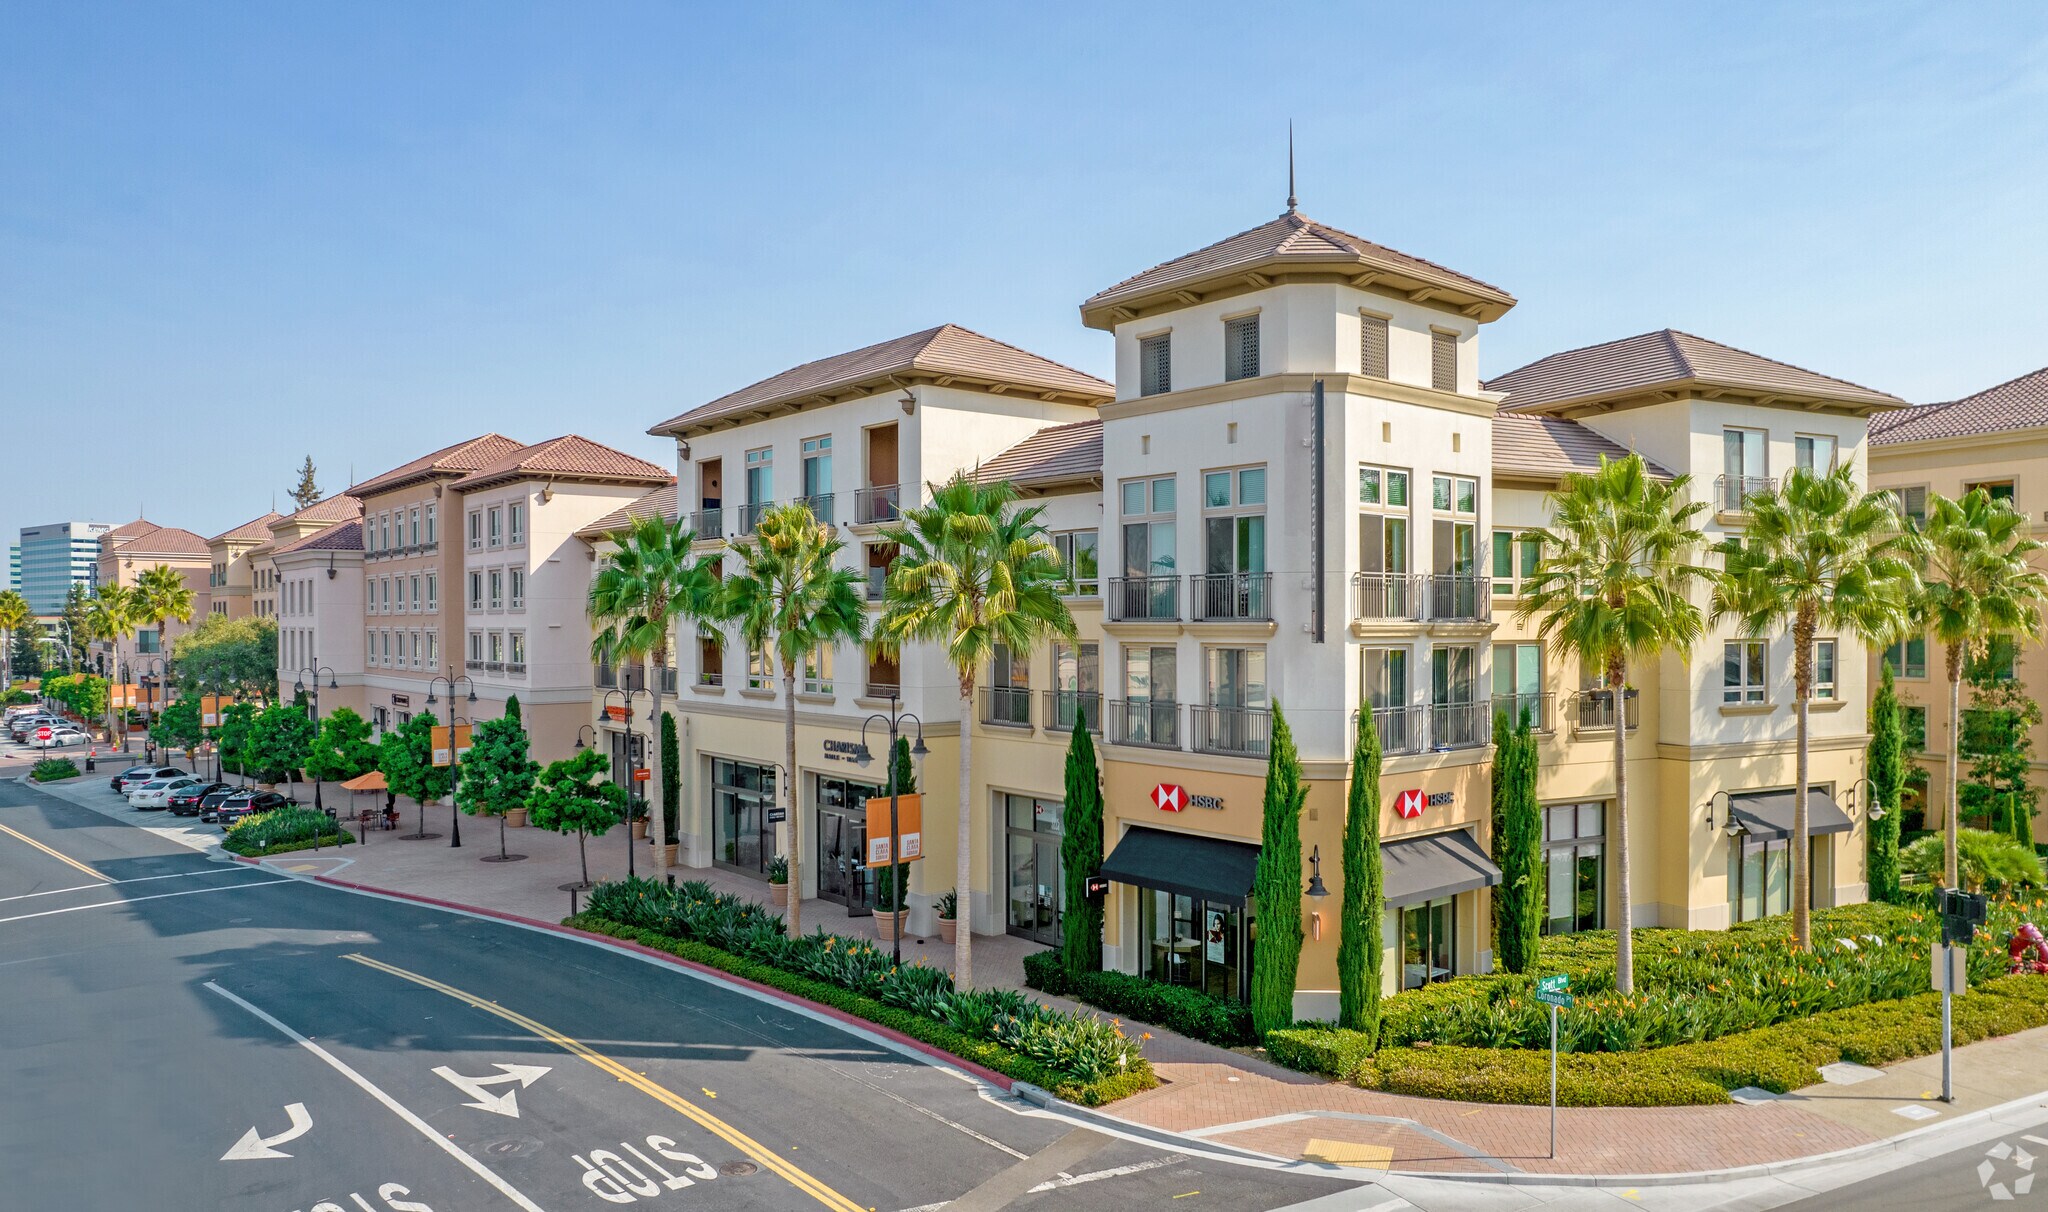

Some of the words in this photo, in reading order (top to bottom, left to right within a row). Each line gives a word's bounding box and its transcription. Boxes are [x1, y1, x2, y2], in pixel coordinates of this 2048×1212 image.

[823, 739, 862, 754] CHARISM
[1190, 794, 1224, 810] HSBC
[1428, 791, 1454, 806] HSBC
[1542, 979, 1556, 990] Scott
[1557, 976, 1567, 984] Blvd
[1537, 989, 1565, 1005] Coronado
[571, 1134, 718, 1204] STOP
